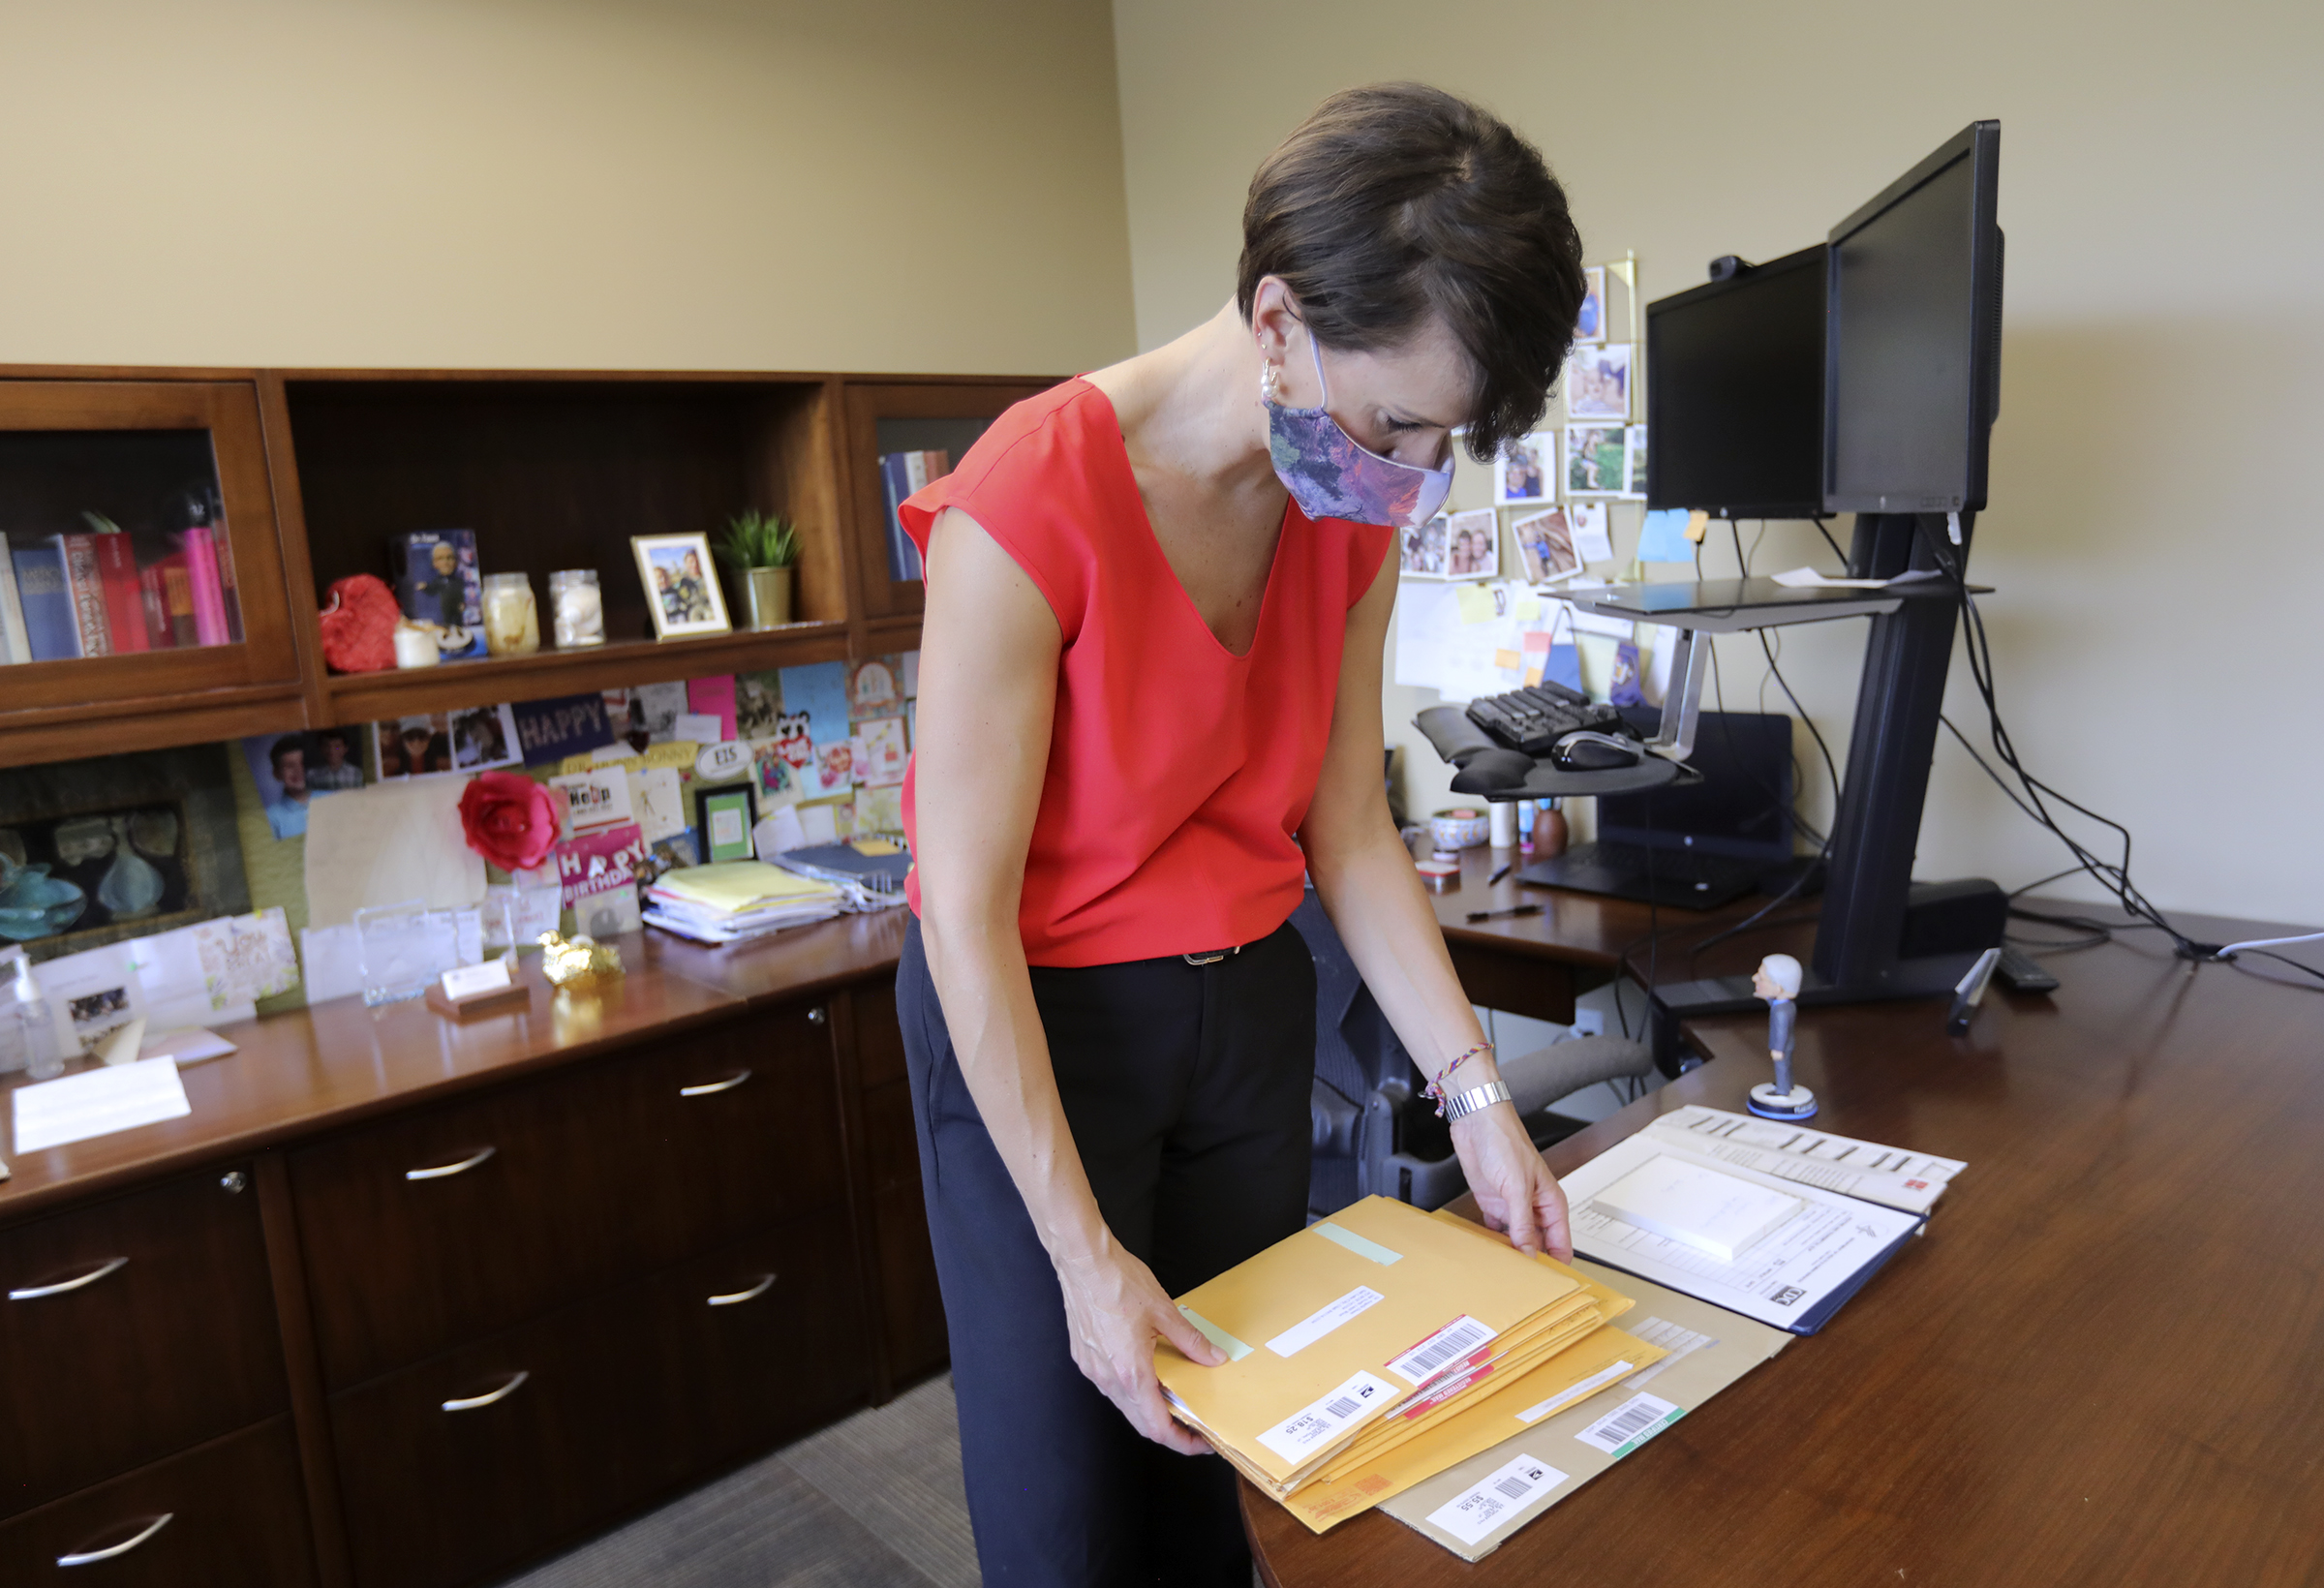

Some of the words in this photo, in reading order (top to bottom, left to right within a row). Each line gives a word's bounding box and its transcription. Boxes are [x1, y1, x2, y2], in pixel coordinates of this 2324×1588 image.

[518, 700, 601, 750] HAPPY
[714, 747, 738, 766] EIS
[1776, 1287, 1803, 1305] CDC
[1443, 1376, 1472, 1395] REGISTERED
[1285, 1416, 1314, 1434] $18.25
[1642, 1418, 1668, 1438] CERTIFIED
[1461, 1495, 1483, 1511] $5.55
